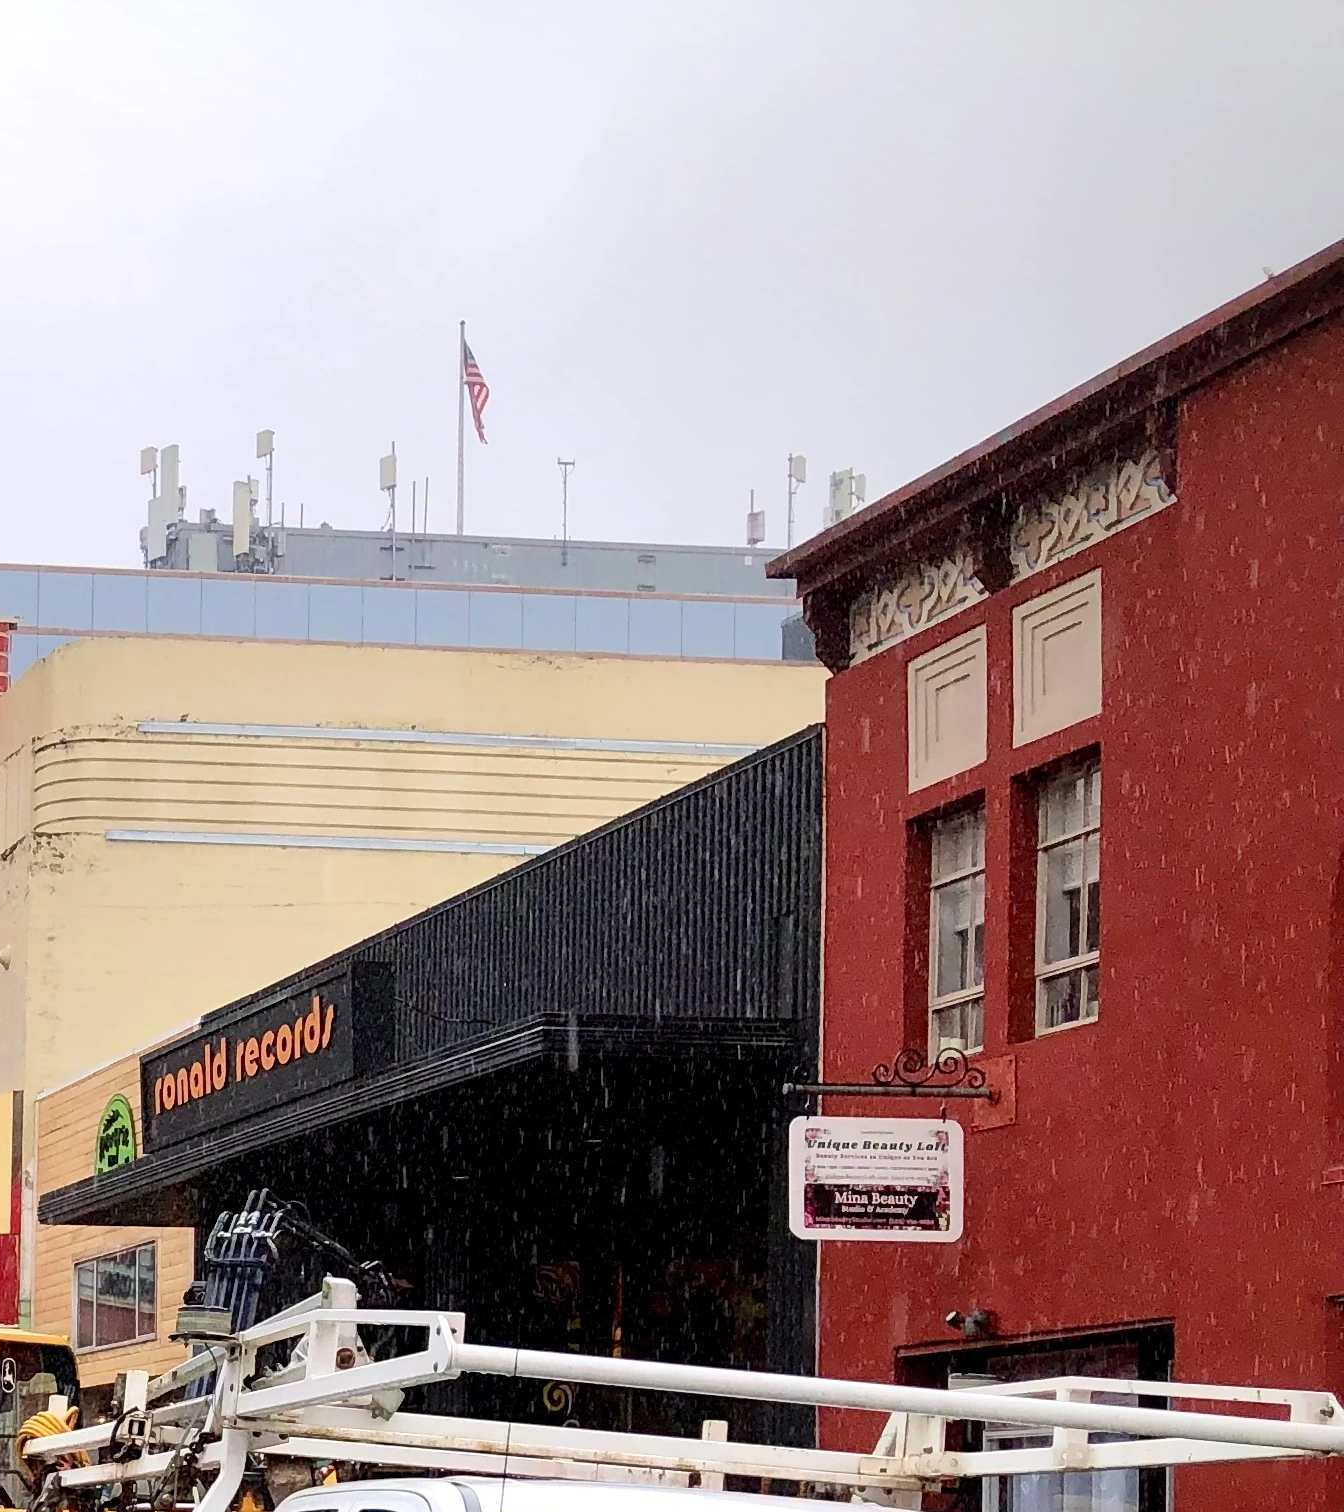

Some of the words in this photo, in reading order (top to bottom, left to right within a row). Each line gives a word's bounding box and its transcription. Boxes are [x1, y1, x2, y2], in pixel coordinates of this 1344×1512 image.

[154, 1036, 227, 1115] ronald
[235, 995, 335, 1082] records
[807, 1139, 859, 1152] Unique
[863, 1140, 913, 1153] Beauty
[917, 1142, 948, 1152] Loft
[834, 1191, 868, 1204] Mina
[871, 1192, 919, 1208] Beauty
